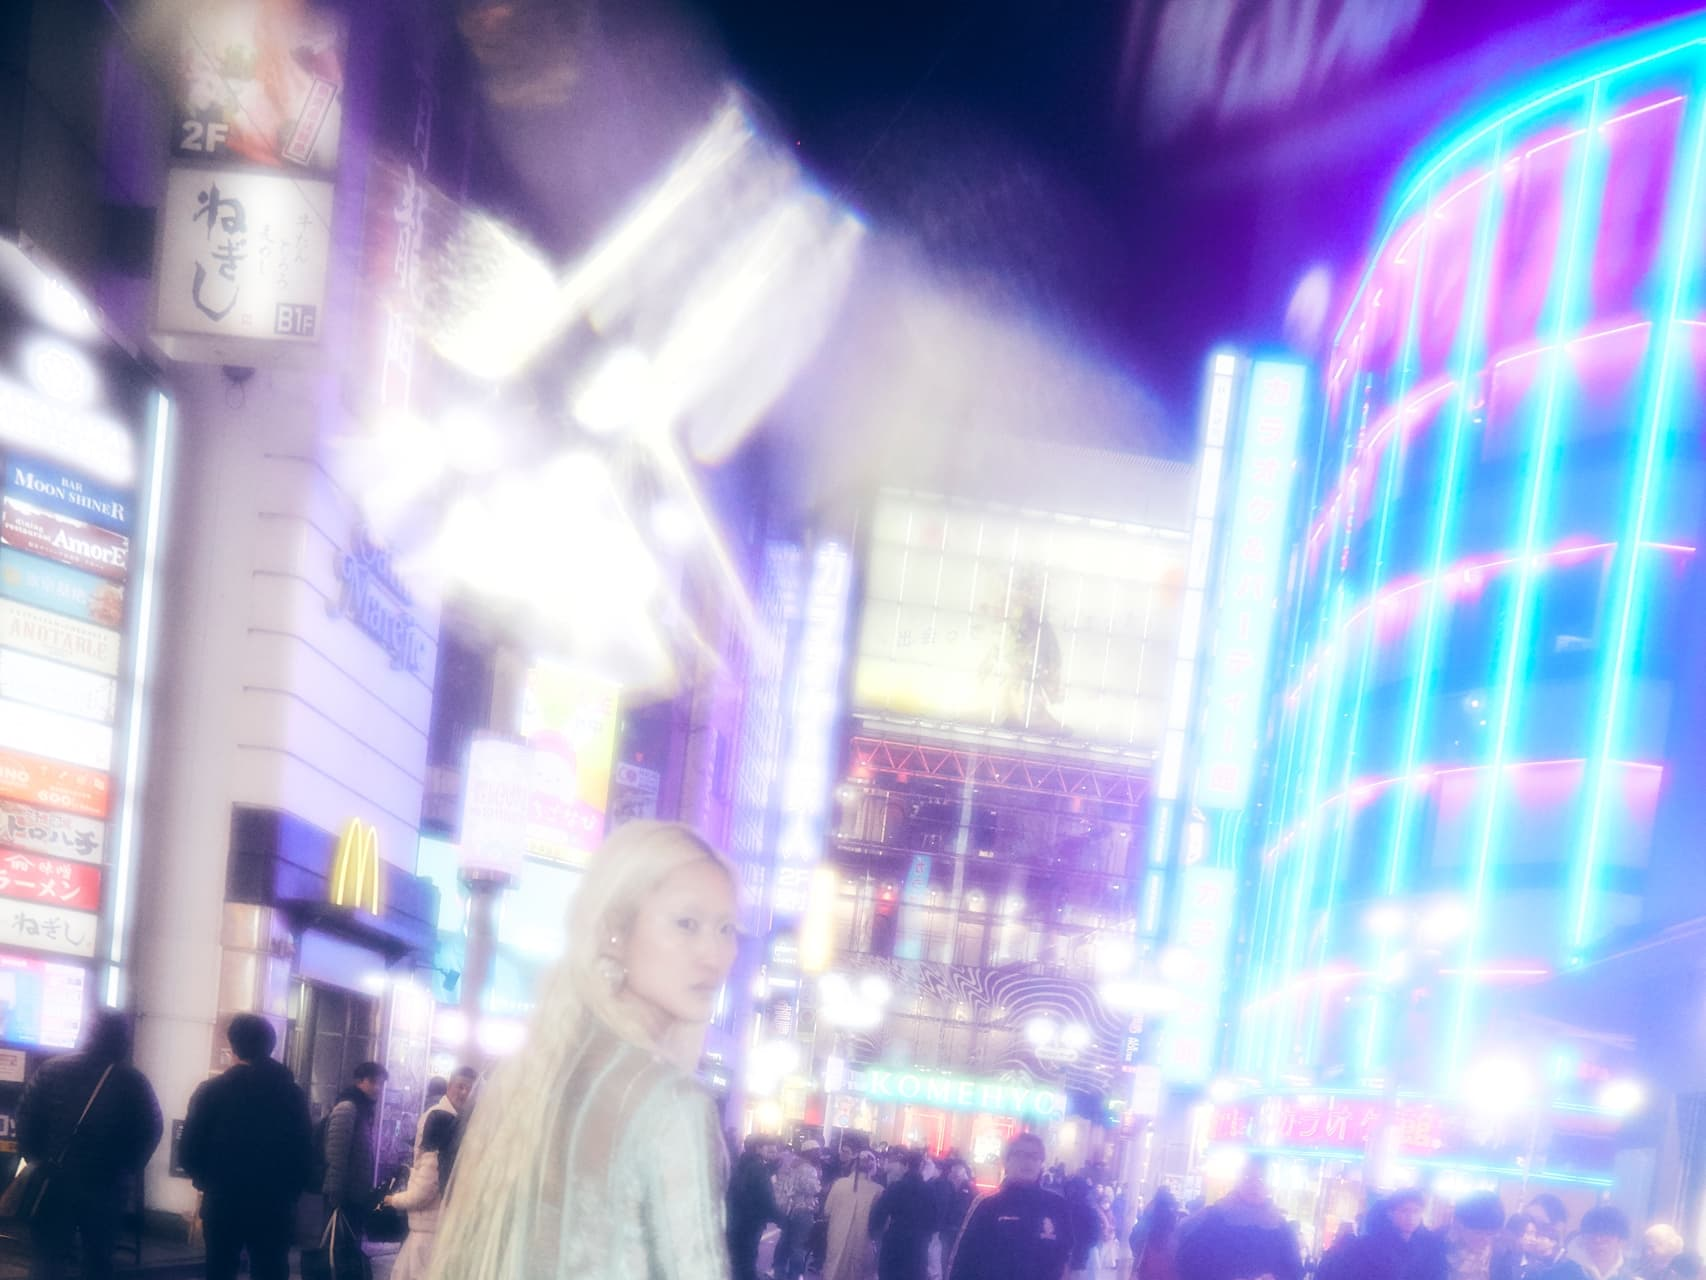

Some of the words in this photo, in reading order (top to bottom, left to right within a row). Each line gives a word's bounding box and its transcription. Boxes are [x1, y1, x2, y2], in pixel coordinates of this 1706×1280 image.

[181, 120, 230, 152] 2F
[192, 182, 248, 322] ねぎし
[277, 306, 316, 335] B1F
[61, 476, 83, 493] BAR
[12, 912, 84, 946] ねぎし
[870, 1069, 1056, 1115] KOMEHYO
